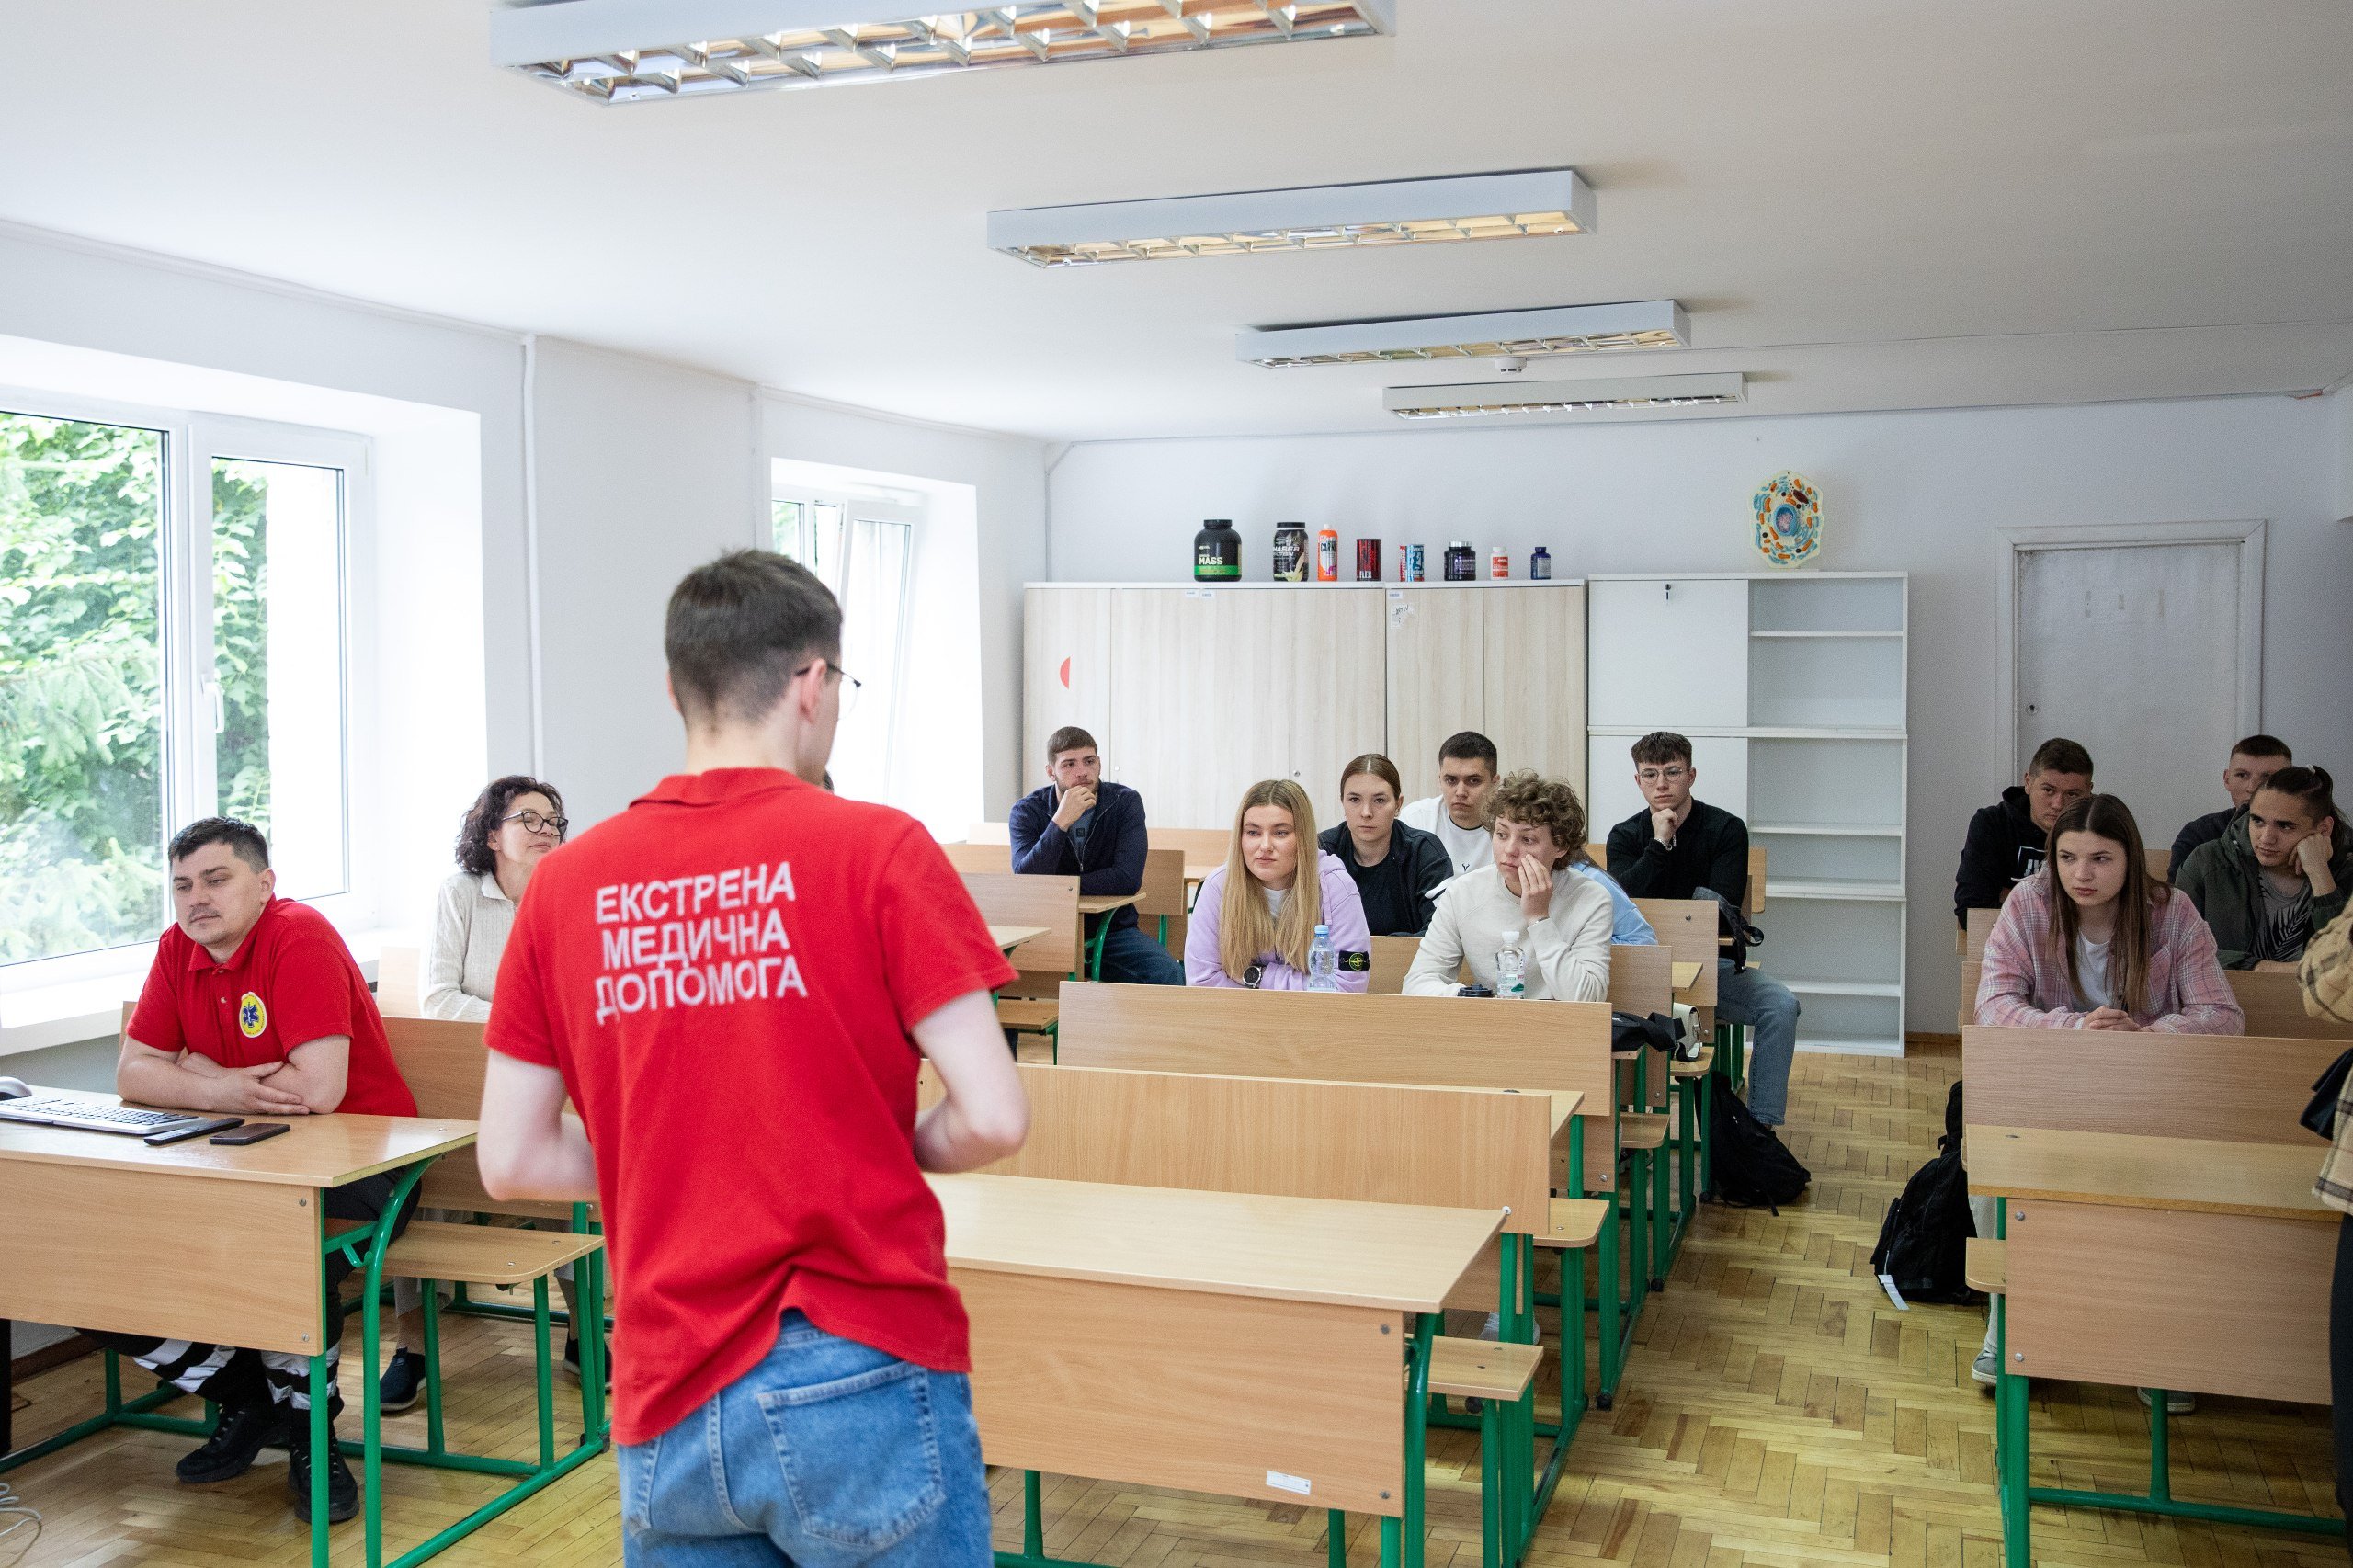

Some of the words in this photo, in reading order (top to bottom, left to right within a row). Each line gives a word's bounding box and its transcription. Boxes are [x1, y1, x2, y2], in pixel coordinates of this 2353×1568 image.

[1199, 556, 1223, 565] MASS
[597, 861, 795, 924] ЕКСТРЕНА
[602, 908, 790, 970] МЕДИЧНА
[595, 955, 808, 1026] ДОПОМОГА
